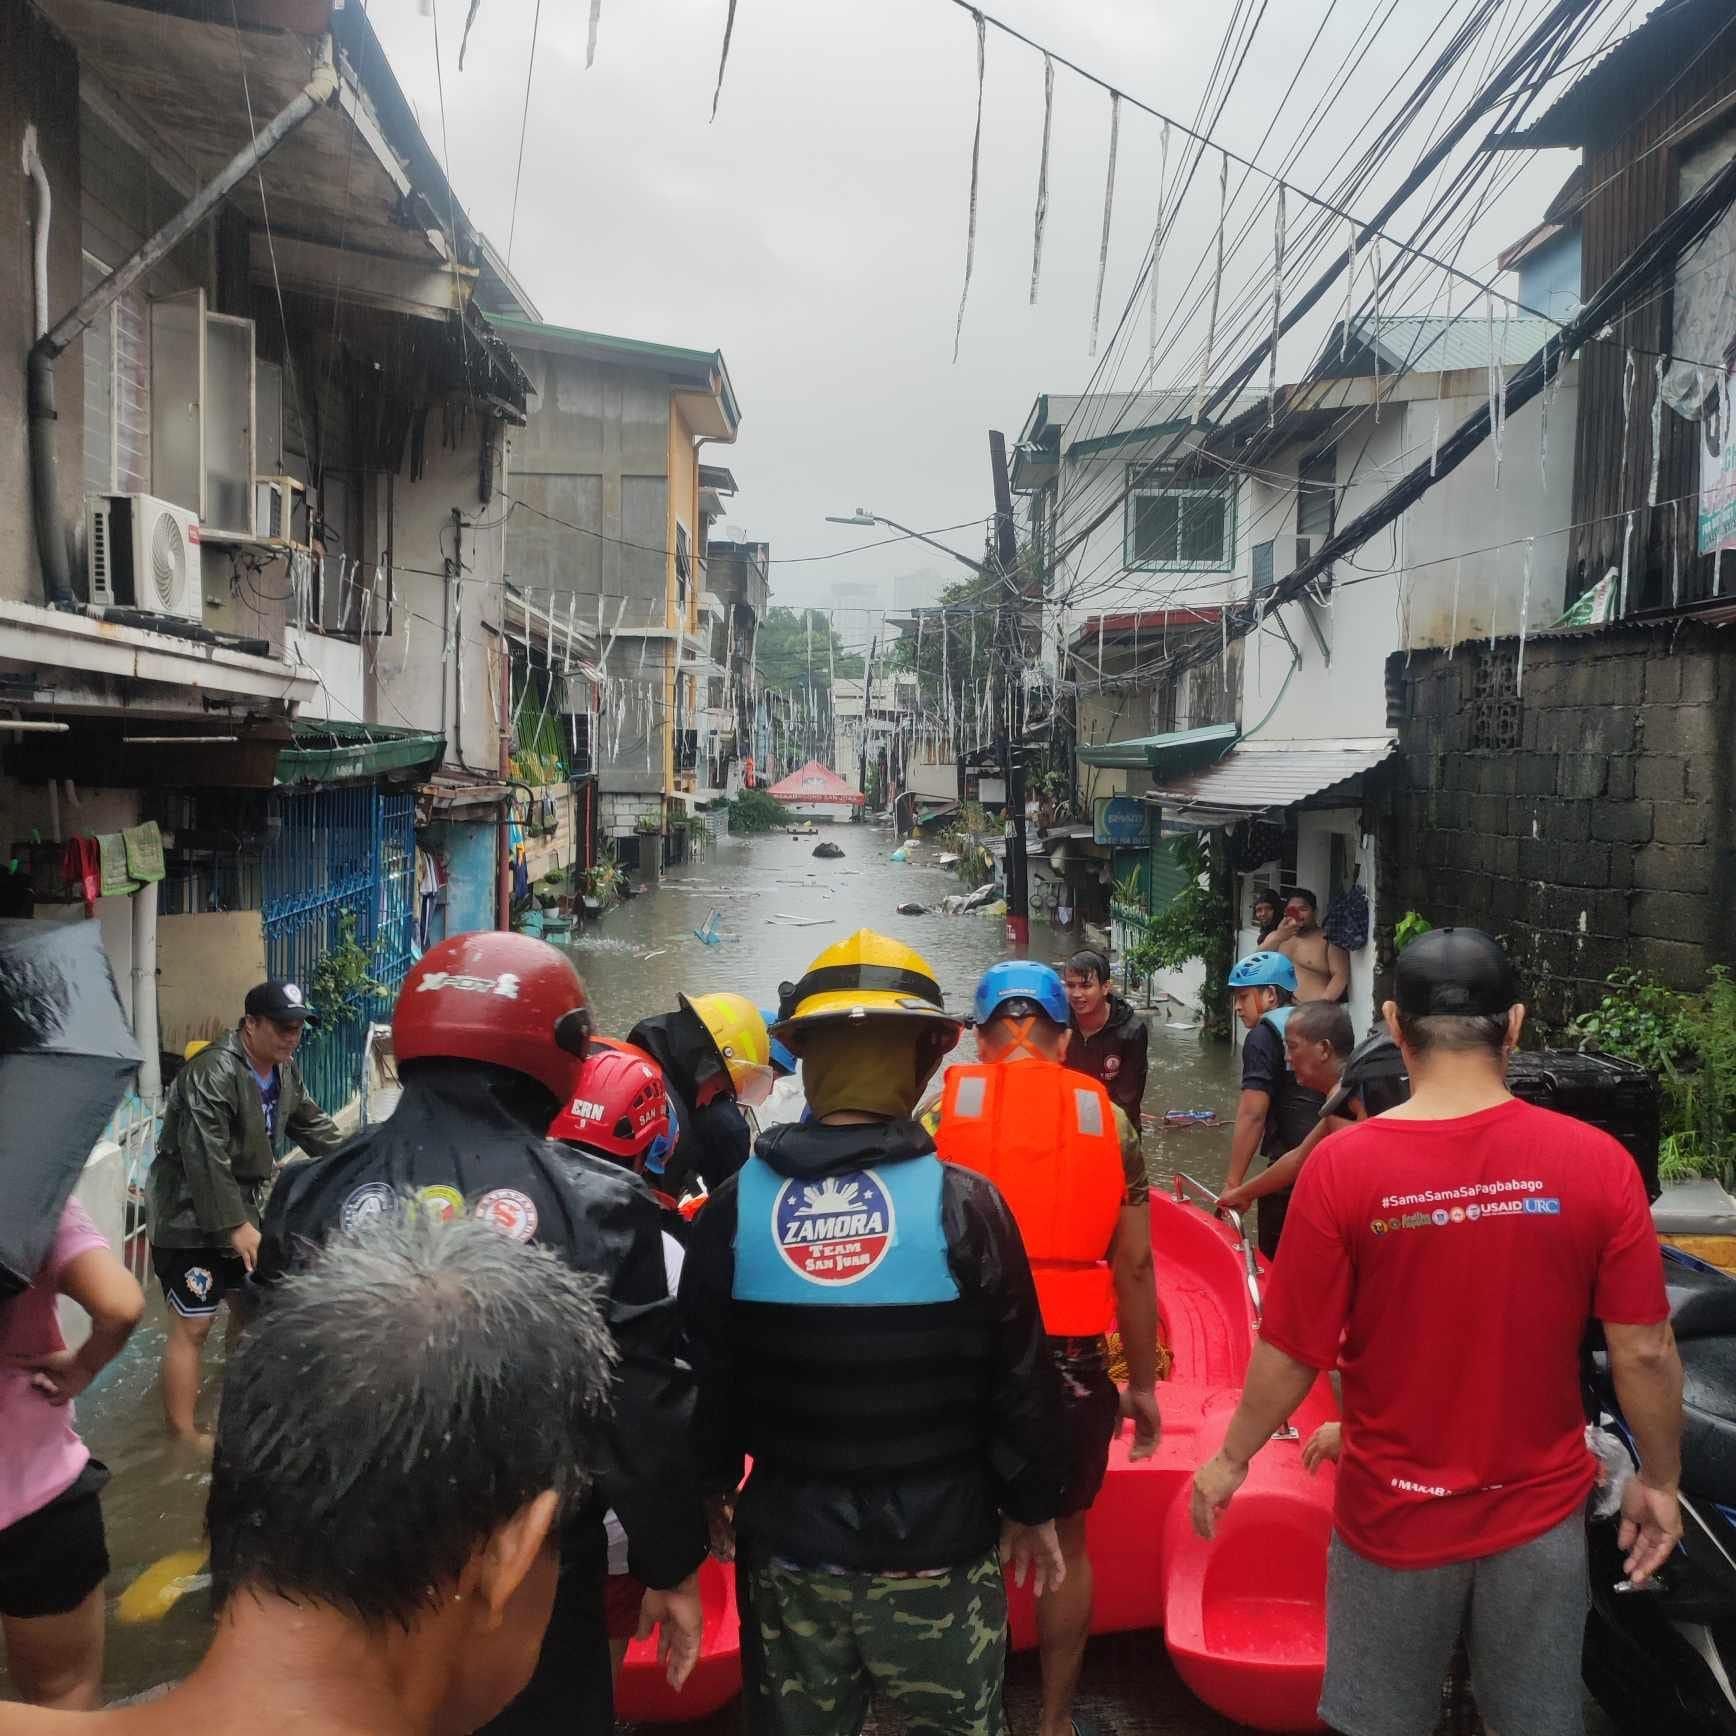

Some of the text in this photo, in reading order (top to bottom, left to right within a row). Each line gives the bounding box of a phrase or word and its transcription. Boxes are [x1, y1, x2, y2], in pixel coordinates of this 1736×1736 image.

[1382, 1179, 1543, 1209] #SamaSamaSaPagbabago
[1481, 1199, 1558, 1214] USAID URC
[784, 1211, 883, 1244] ZAMORA
